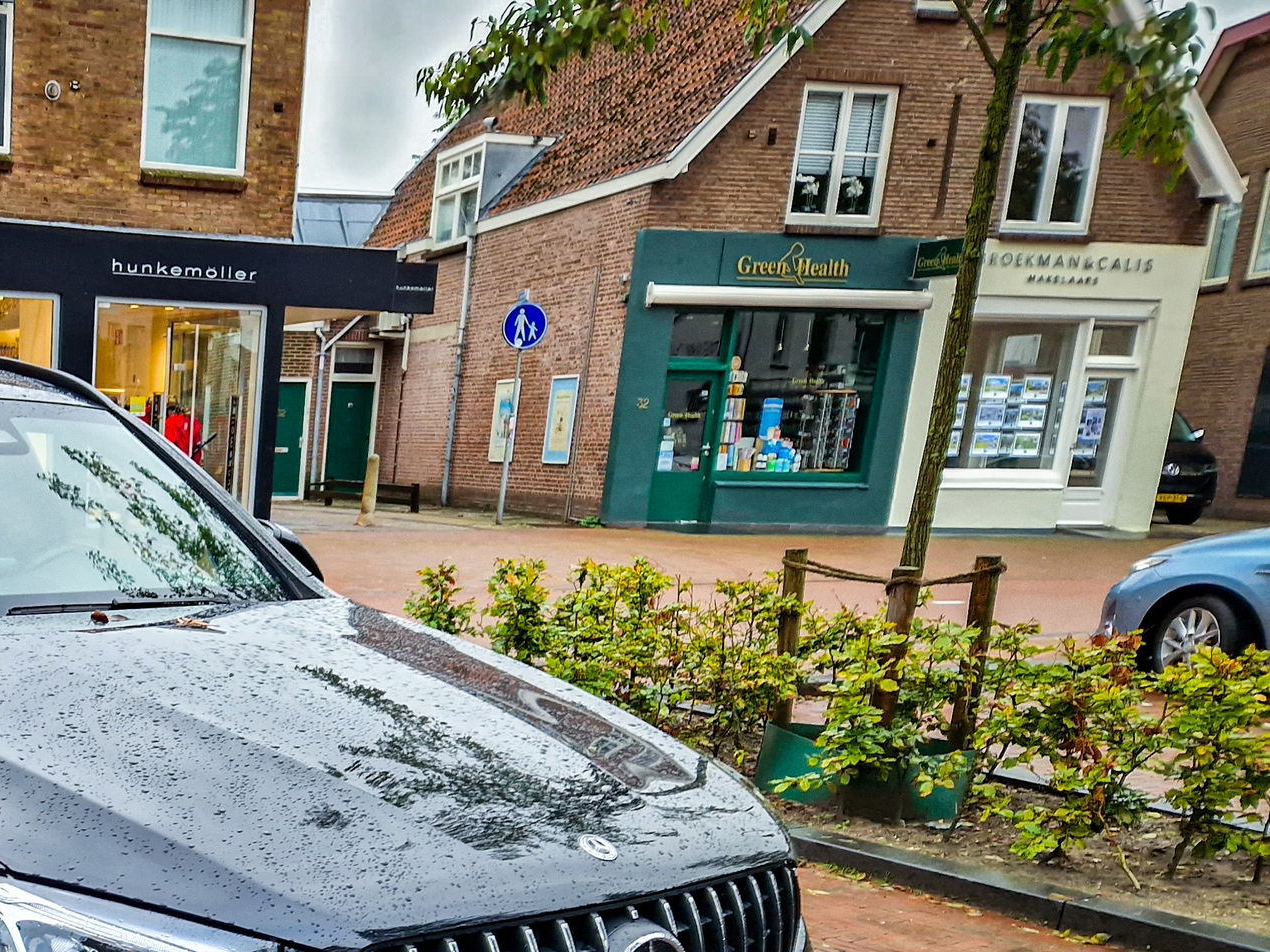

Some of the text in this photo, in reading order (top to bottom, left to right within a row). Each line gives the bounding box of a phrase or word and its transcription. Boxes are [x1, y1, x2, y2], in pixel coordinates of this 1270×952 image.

[111, 257, 258, 281] hunkemöller
[737, 255, 850, 278] Green Health
